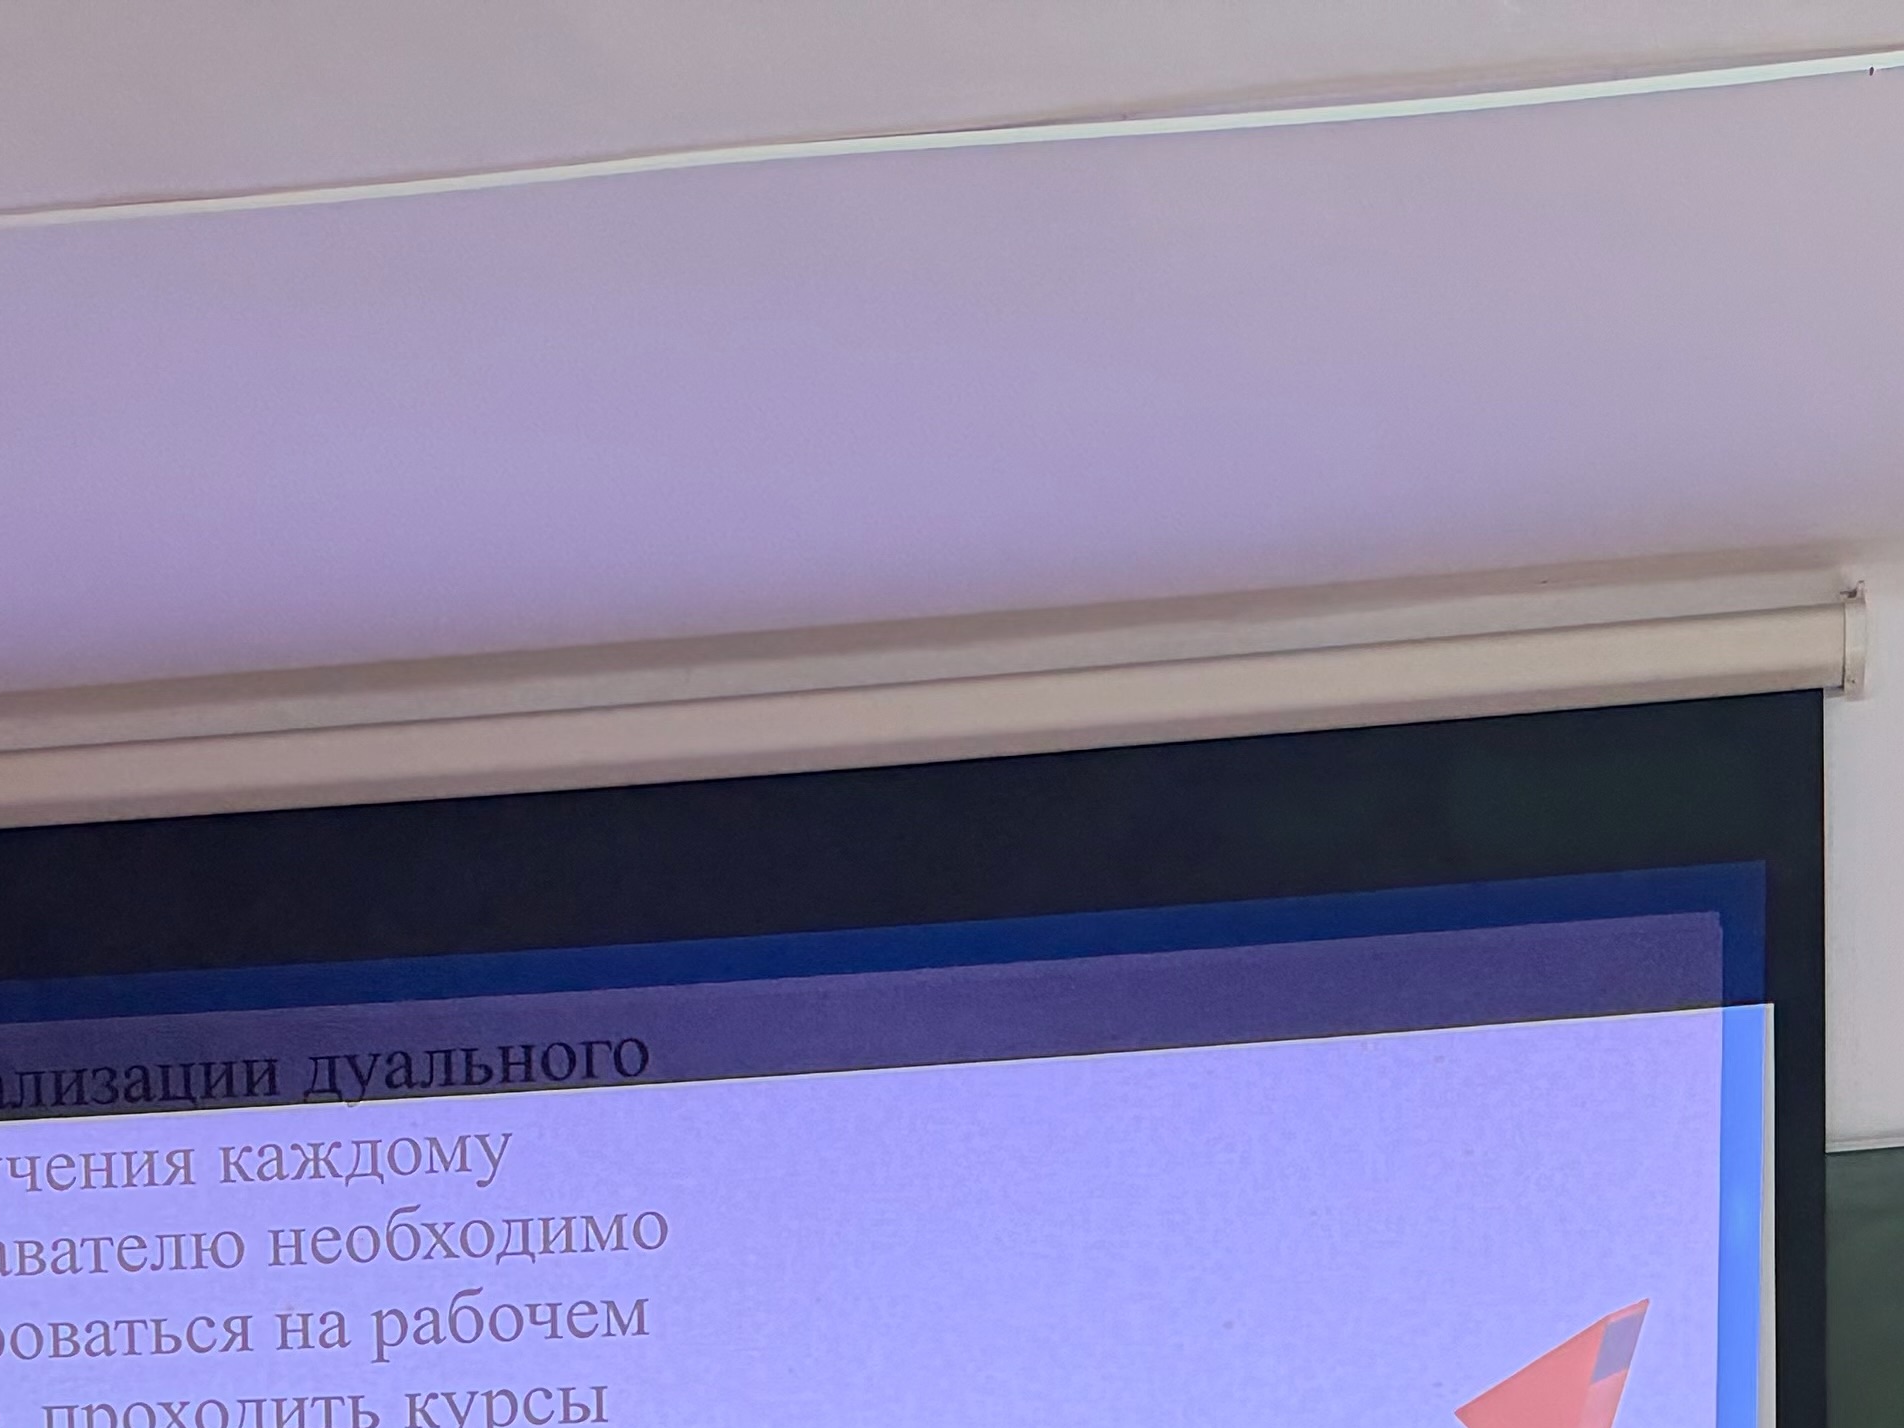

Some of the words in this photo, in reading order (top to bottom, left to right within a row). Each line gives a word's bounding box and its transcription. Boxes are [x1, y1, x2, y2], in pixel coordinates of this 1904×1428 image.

[303, 1037, 650, 1107] дуального
[219, 1132, 512, 1188] каждому
[268, 1204, 669, 1266] необходимо
[276, 1310, 351, 1350] на
[371, 1286, 650, 1363] рабочем
